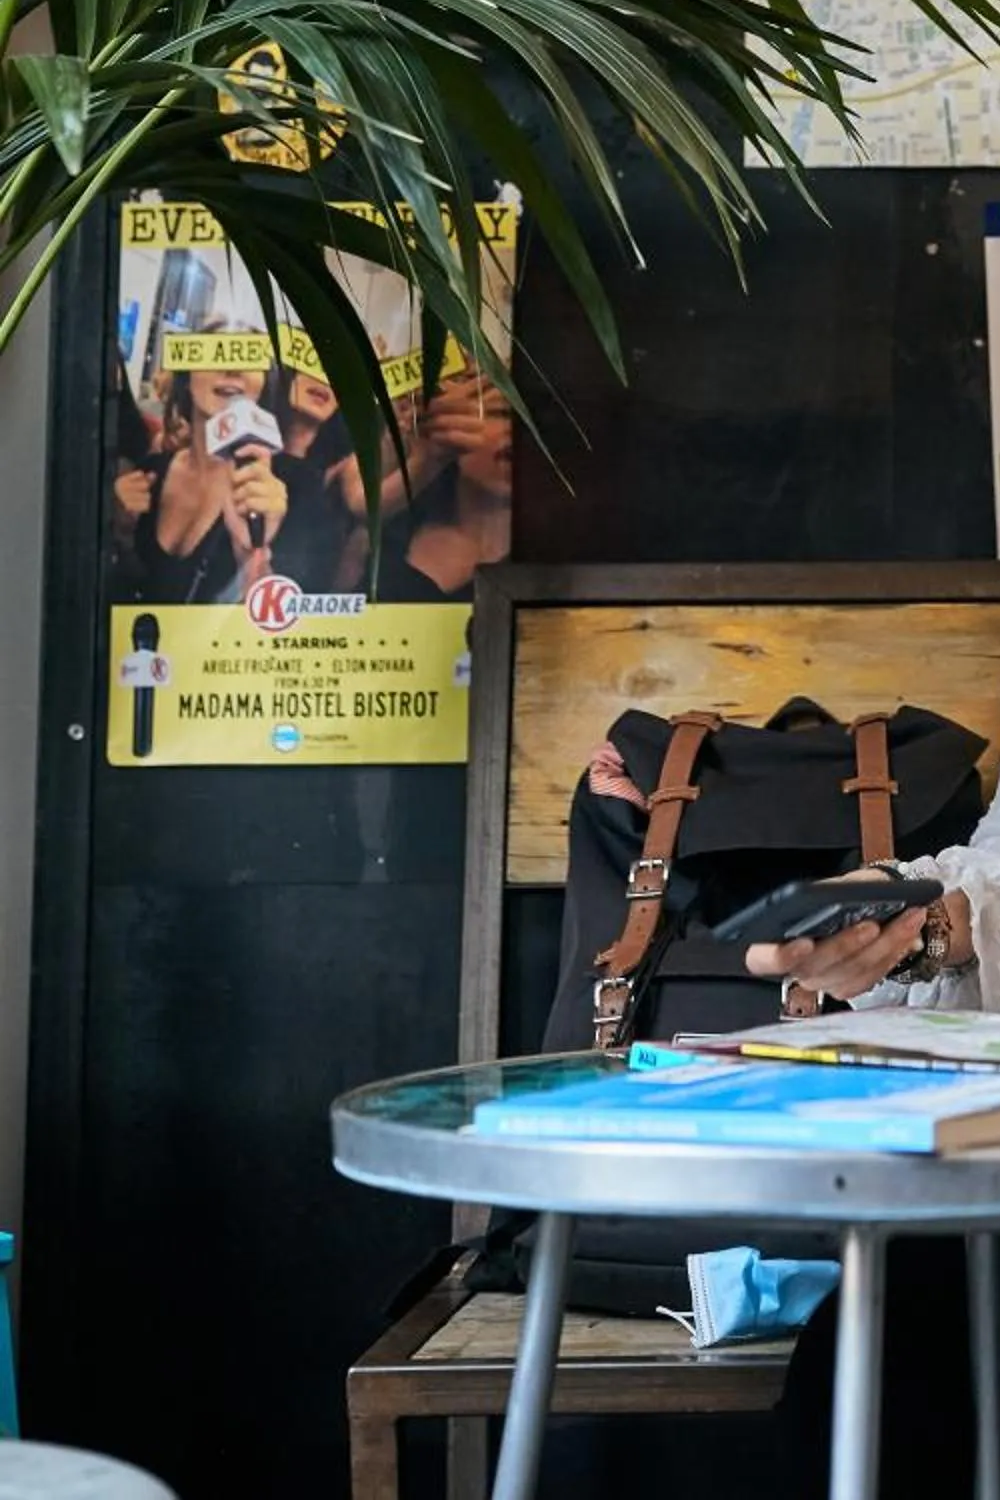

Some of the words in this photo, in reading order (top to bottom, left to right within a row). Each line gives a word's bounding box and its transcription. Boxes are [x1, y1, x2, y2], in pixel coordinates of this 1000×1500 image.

[169, 341, 204, 363] WE
[212, 339, 263, 363] ARE
[271, 637, 348, 650] STARRING
[179, 694, 263, 718] MADAMA
[272, 693, 345, 718] HOSTEL
[354, 691, 439, 717] BISTROT
